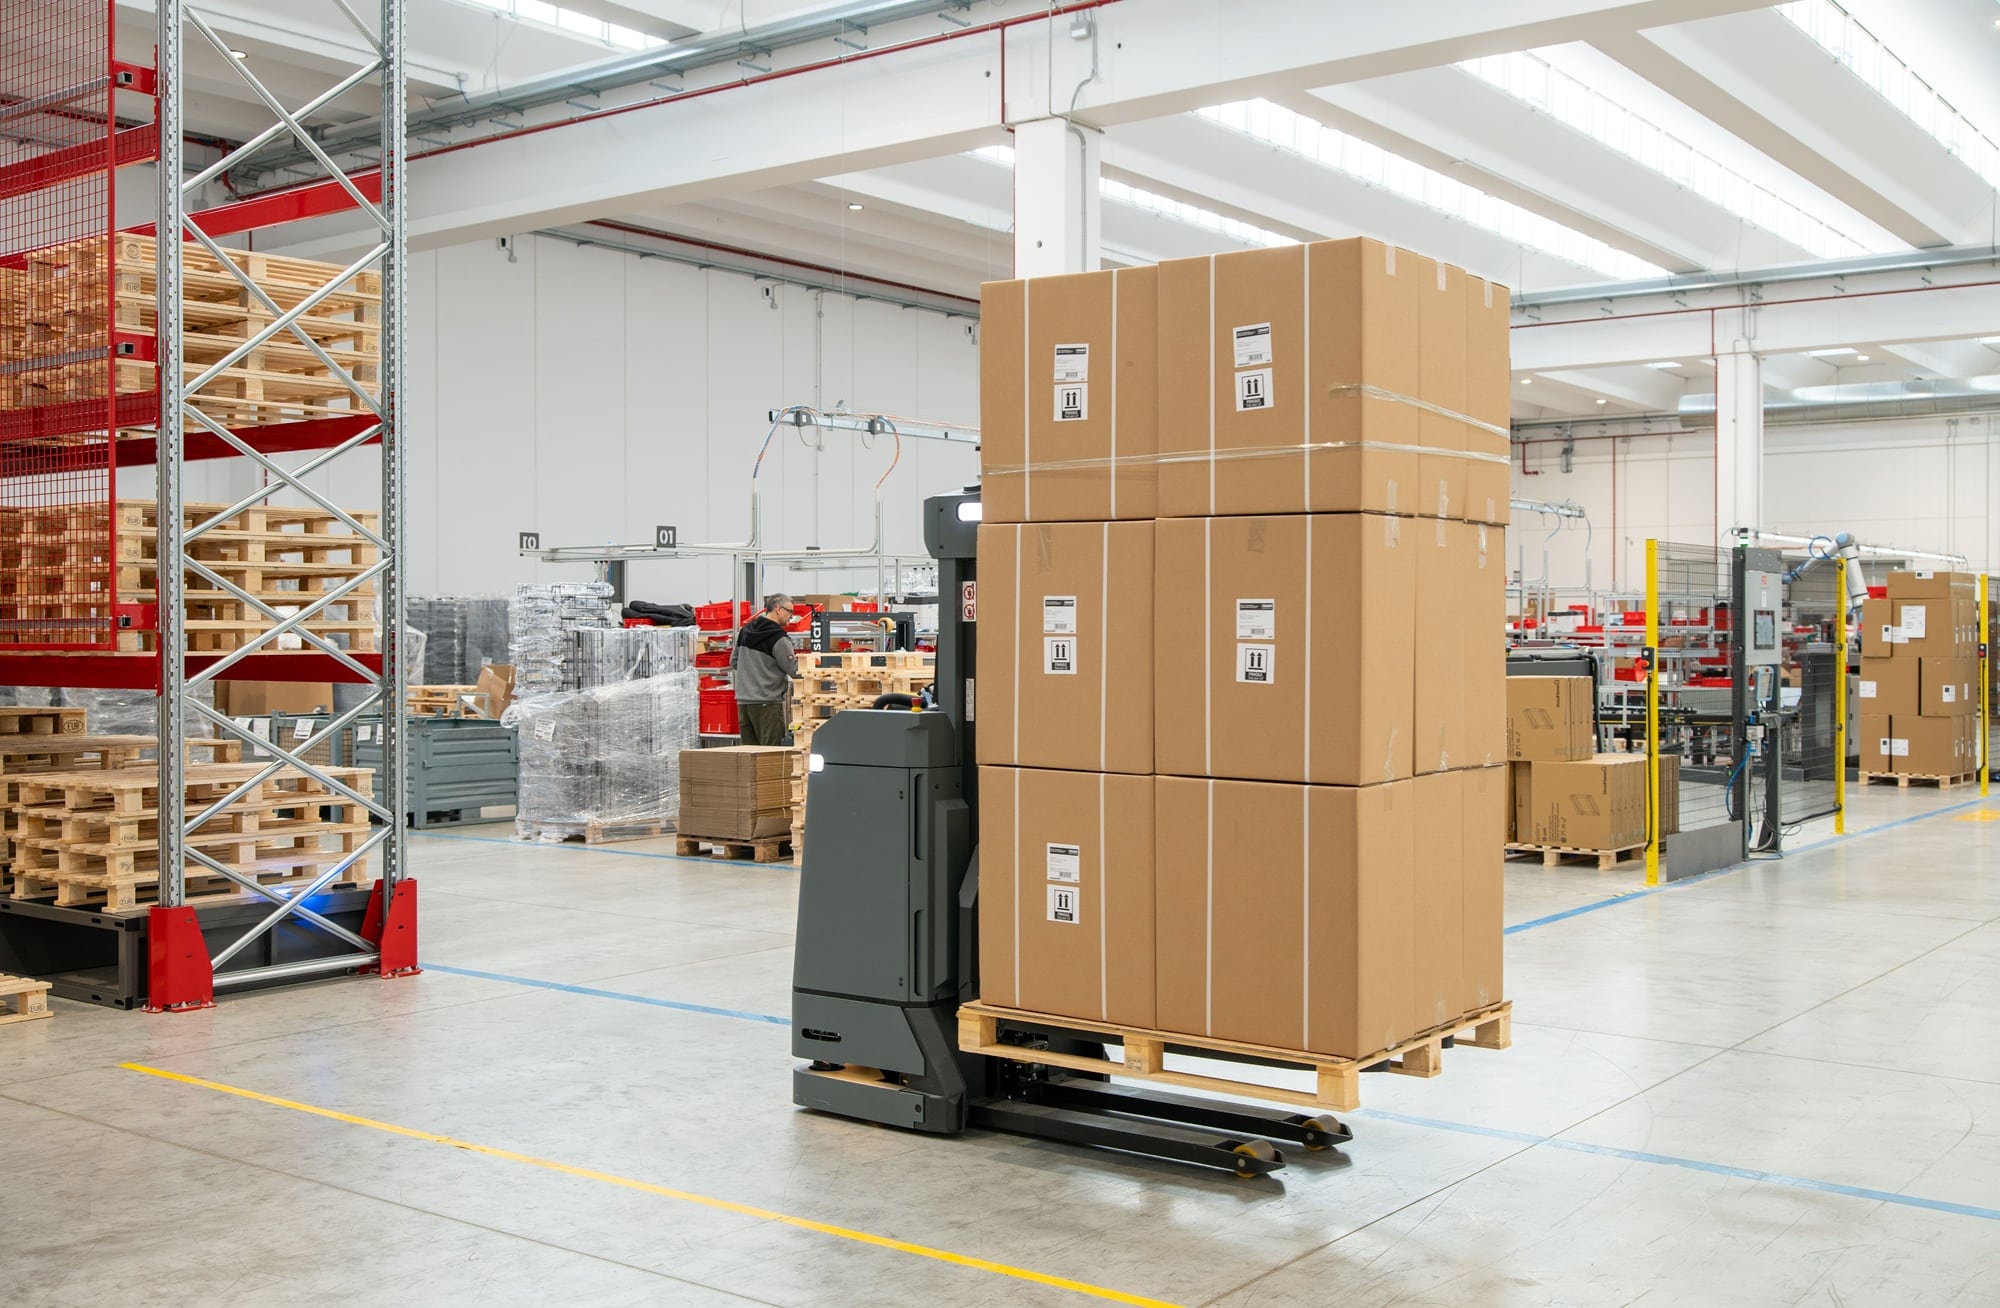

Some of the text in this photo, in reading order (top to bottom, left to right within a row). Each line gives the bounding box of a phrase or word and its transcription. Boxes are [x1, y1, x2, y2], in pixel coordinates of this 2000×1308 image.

[659, 530, 673, 544] 01
[811, 620, 821, 651] siat
[67, 721, 80, 730] EUR
[30, 1004, 43, 1012] EUR
